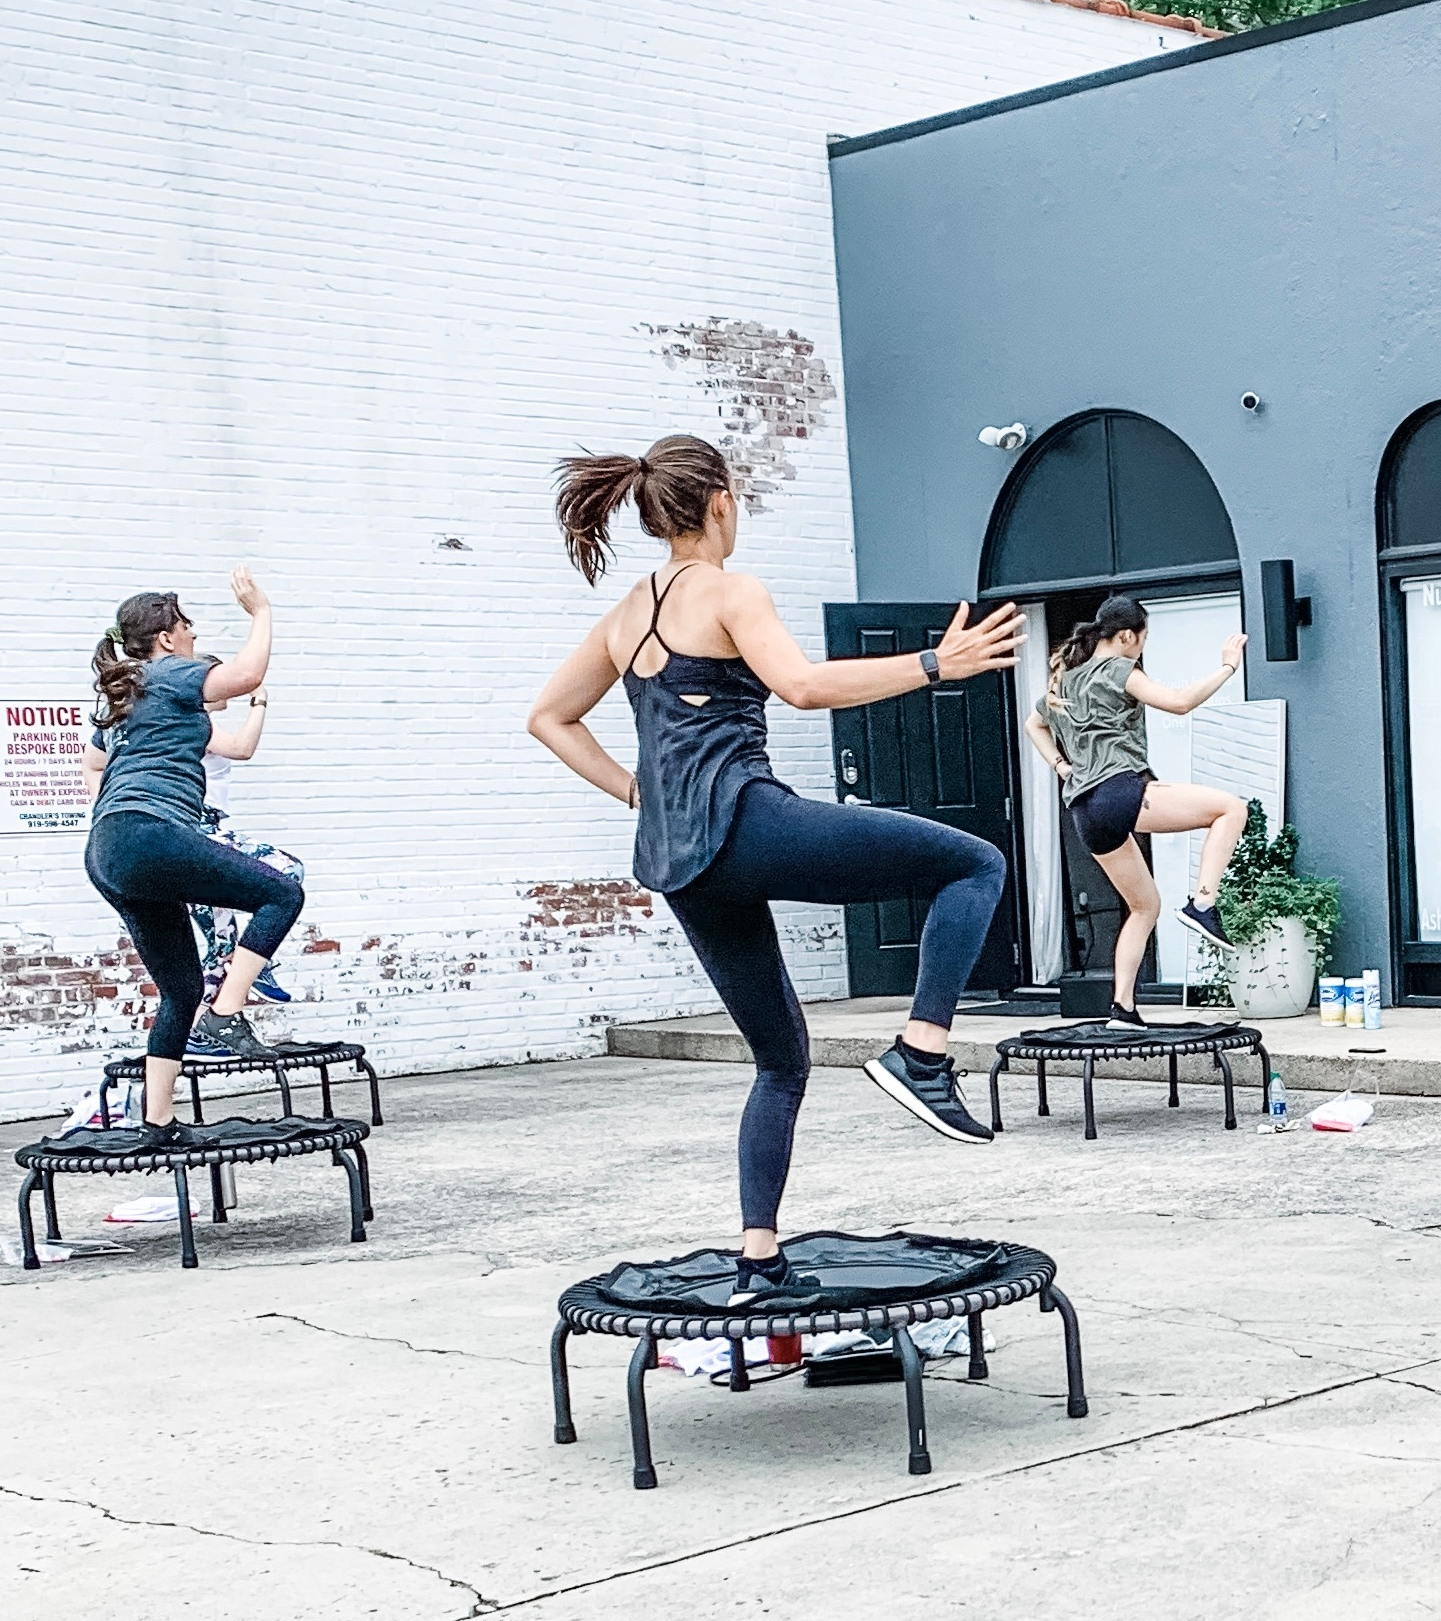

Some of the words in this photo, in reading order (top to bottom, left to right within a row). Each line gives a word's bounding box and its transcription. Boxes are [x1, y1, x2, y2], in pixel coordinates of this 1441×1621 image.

[6, 707, 83, 726] NOTICE
[13, 732, 57, 741] PARKING
[60, 732, 79, 741] FOR
[7, 743, 56, 754] BESPOKE
[59, 743, 86, 754] BODY
